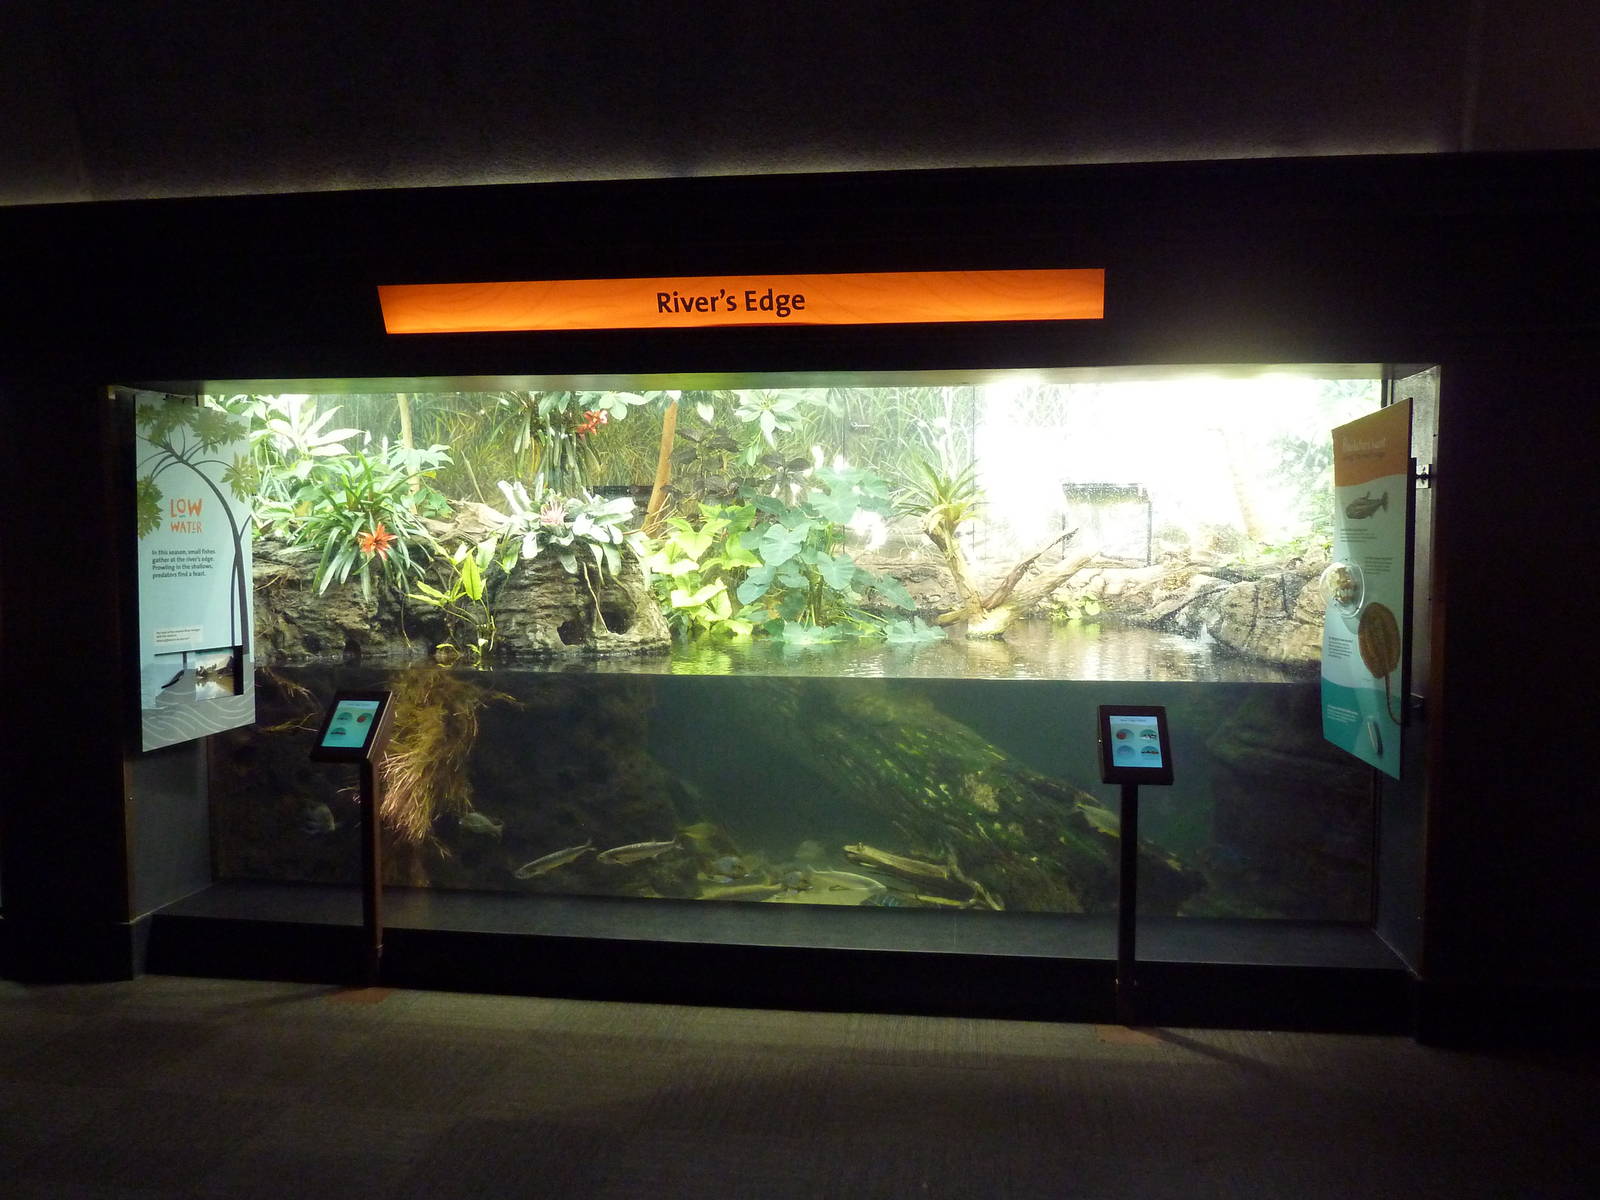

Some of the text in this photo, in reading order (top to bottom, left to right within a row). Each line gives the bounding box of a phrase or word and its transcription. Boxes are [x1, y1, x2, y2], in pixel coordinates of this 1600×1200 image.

[656, 288, 806, 318] River's Edge
[170, 498, 202, 518] LOW
[170, 521, 202, 534] WATER
[152, 557, 169, 565] gather
[152, 572, 177, 580] predators
